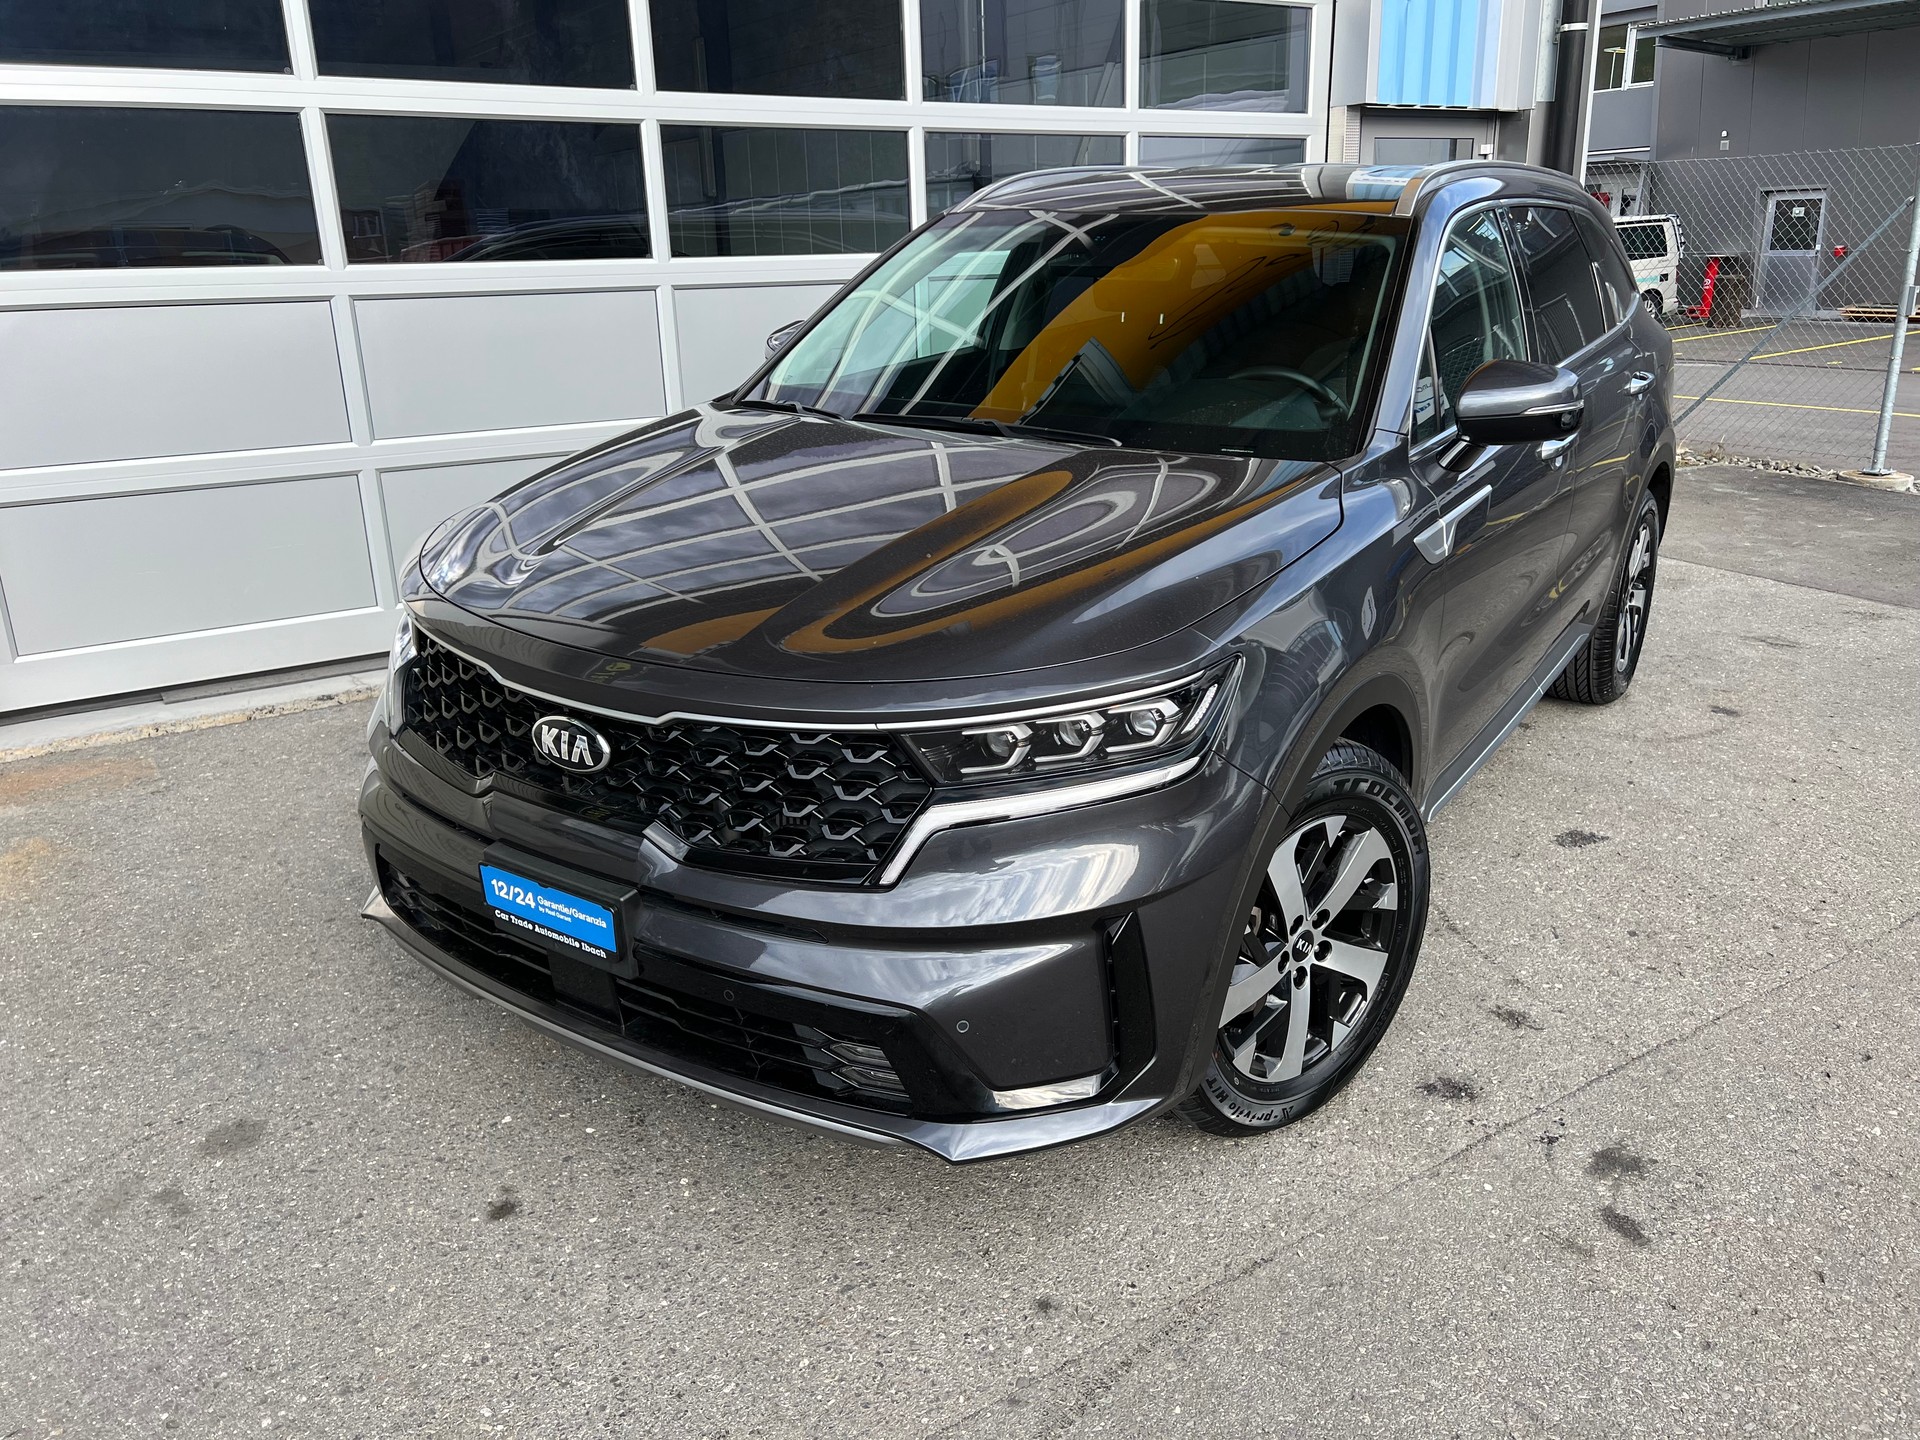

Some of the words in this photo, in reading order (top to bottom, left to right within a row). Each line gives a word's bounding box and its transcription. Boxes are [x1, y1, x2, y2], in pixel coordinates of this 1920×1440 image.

[541, 724, 594, 766] KIA
[490, 878, 536, 909] 12/24
[537, 895, 607, 929] Garantie/Garanzia
[494, 909, 509, 921] Car
[510, 915, 533, 931] Trade
[534, 924, 580, 949] Automobile
[581, 942, 607, 959] Ibach
[1296, 938, 1312, 954] KIA
